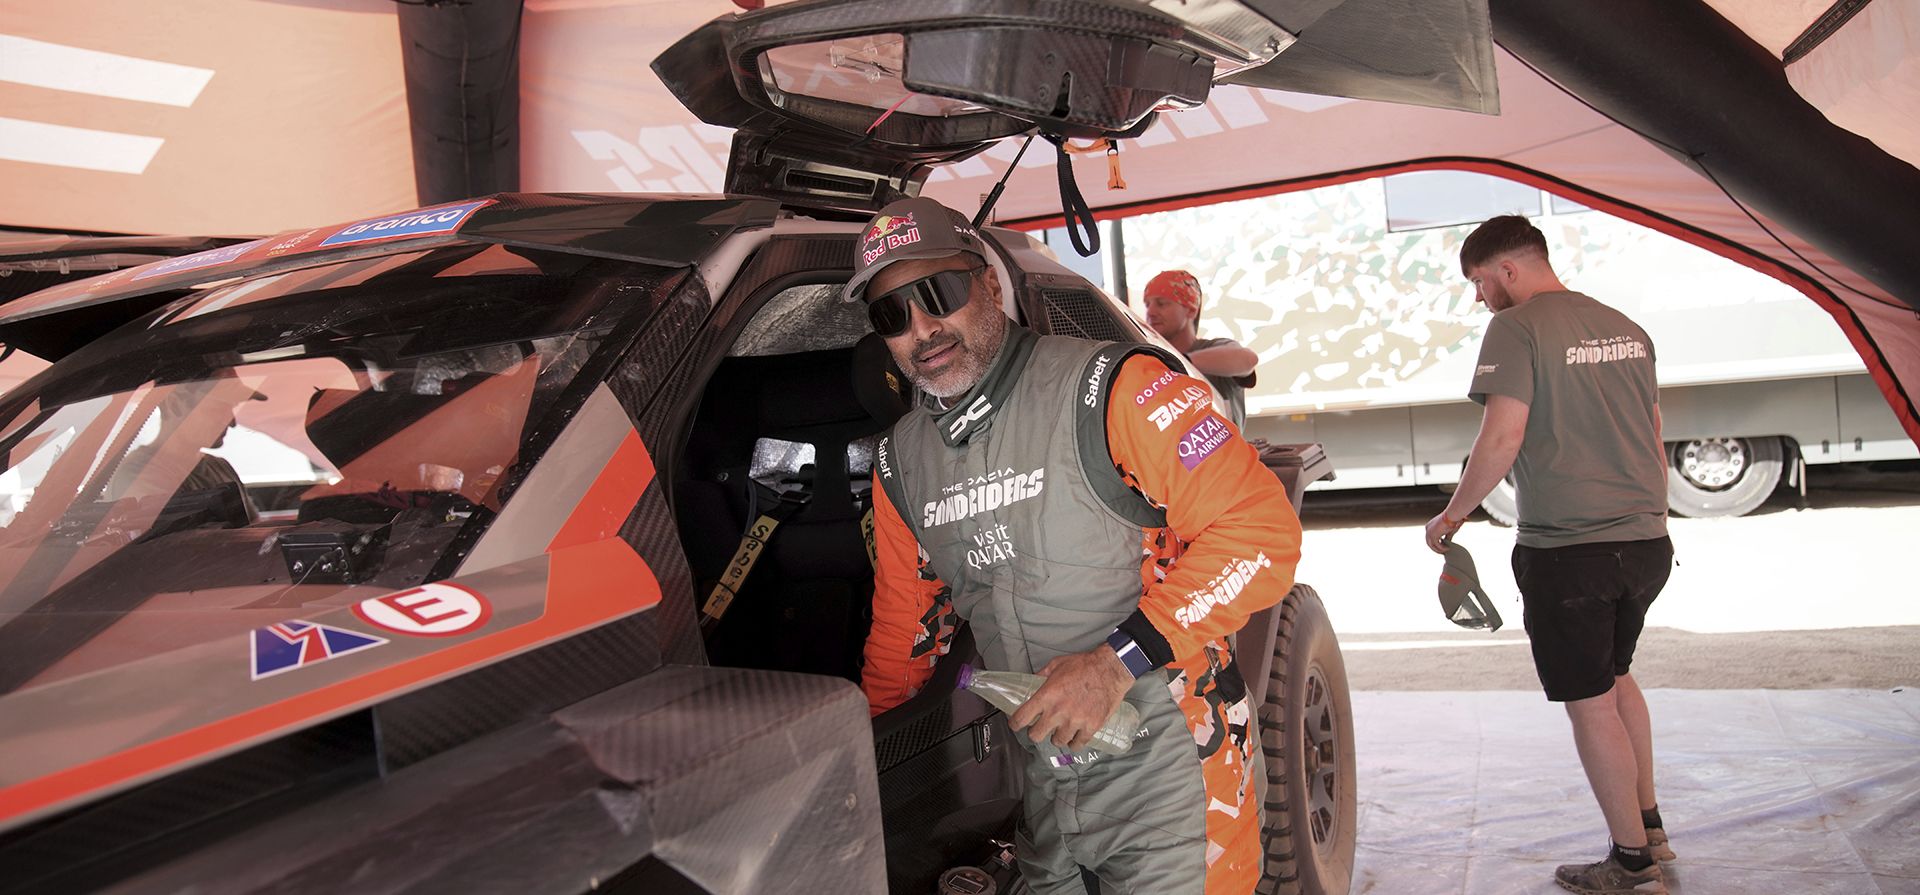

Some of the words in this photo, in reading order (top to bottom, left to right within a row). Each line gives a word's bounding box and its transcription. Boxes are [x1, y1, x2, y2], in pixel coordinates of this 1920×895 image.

[342, 209, 464, 236] aramco
[863, 242, 886, 267] Red
[887, 227, 921, 250] Bull
[1580, 338, 1599, 346] THE
[1600, 335, 1633, 345] DACIA
[1084, 354, 1110, 408] Sabelt
[1197, 427, 1230, 458] AIRWAYS
[878, 436, 893, 480] Sabelt
[942, 482, 963, 495] THE
[968, 467, 1015, 485] DACIA
[923, 467, 1045, 528] SANDRIDERS
[973, 523, 1011, 546] visit
[711, 524, 769, 609] Sabelt
[967, 542, 1016, 570] QATAR
[1207, 558, 1240, 587] DACIA
[376, 587, 469, 626] E
[1073, 755, 1086, 765] N.
